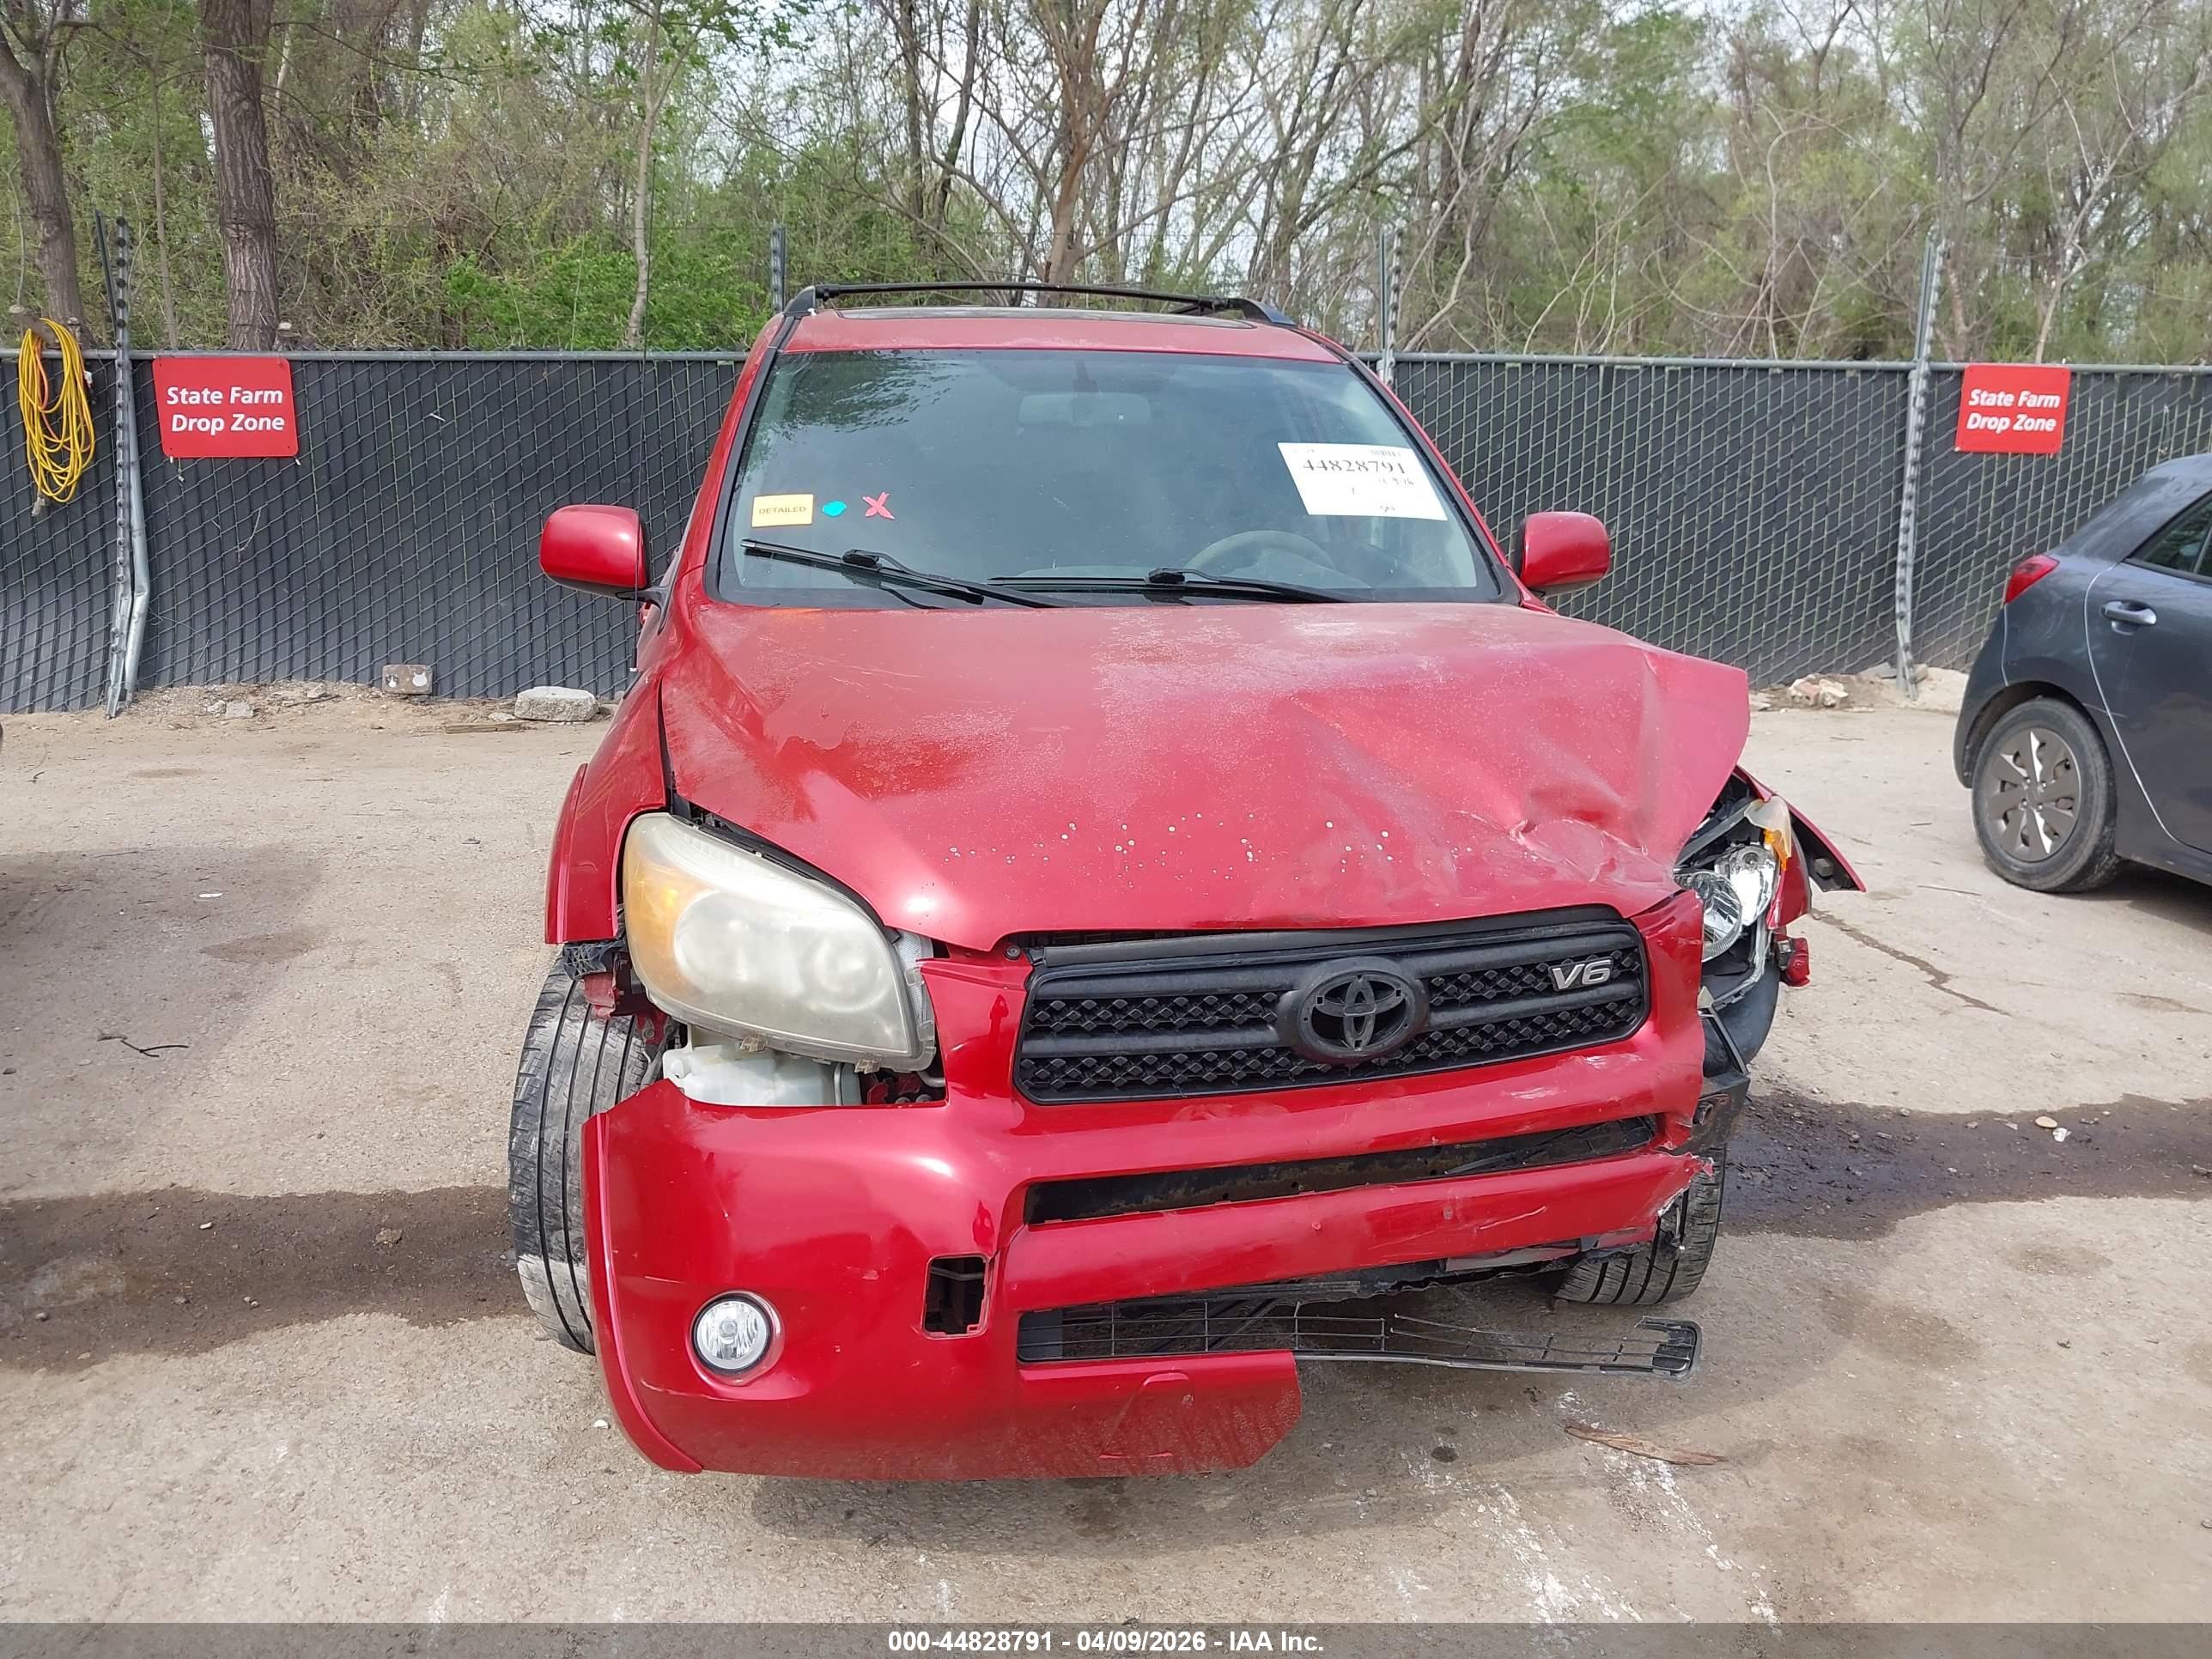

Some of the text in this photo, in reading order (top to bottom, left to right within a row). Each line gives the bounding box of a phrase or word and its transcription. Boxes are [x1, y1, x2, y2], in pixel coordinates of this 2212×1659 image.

[167, 386, 283, 405] State Farm
[1968, 388, 2061, 409] State Farm
[171, 413, 285, 436] Drop Zone
[1966, 412, 2057, 434] Drop Zone
[1302, 459, 1406, 475] 44828791
[758, 505, 806, 515] DETAILED
[1552, 959, 1612, 990] V6
